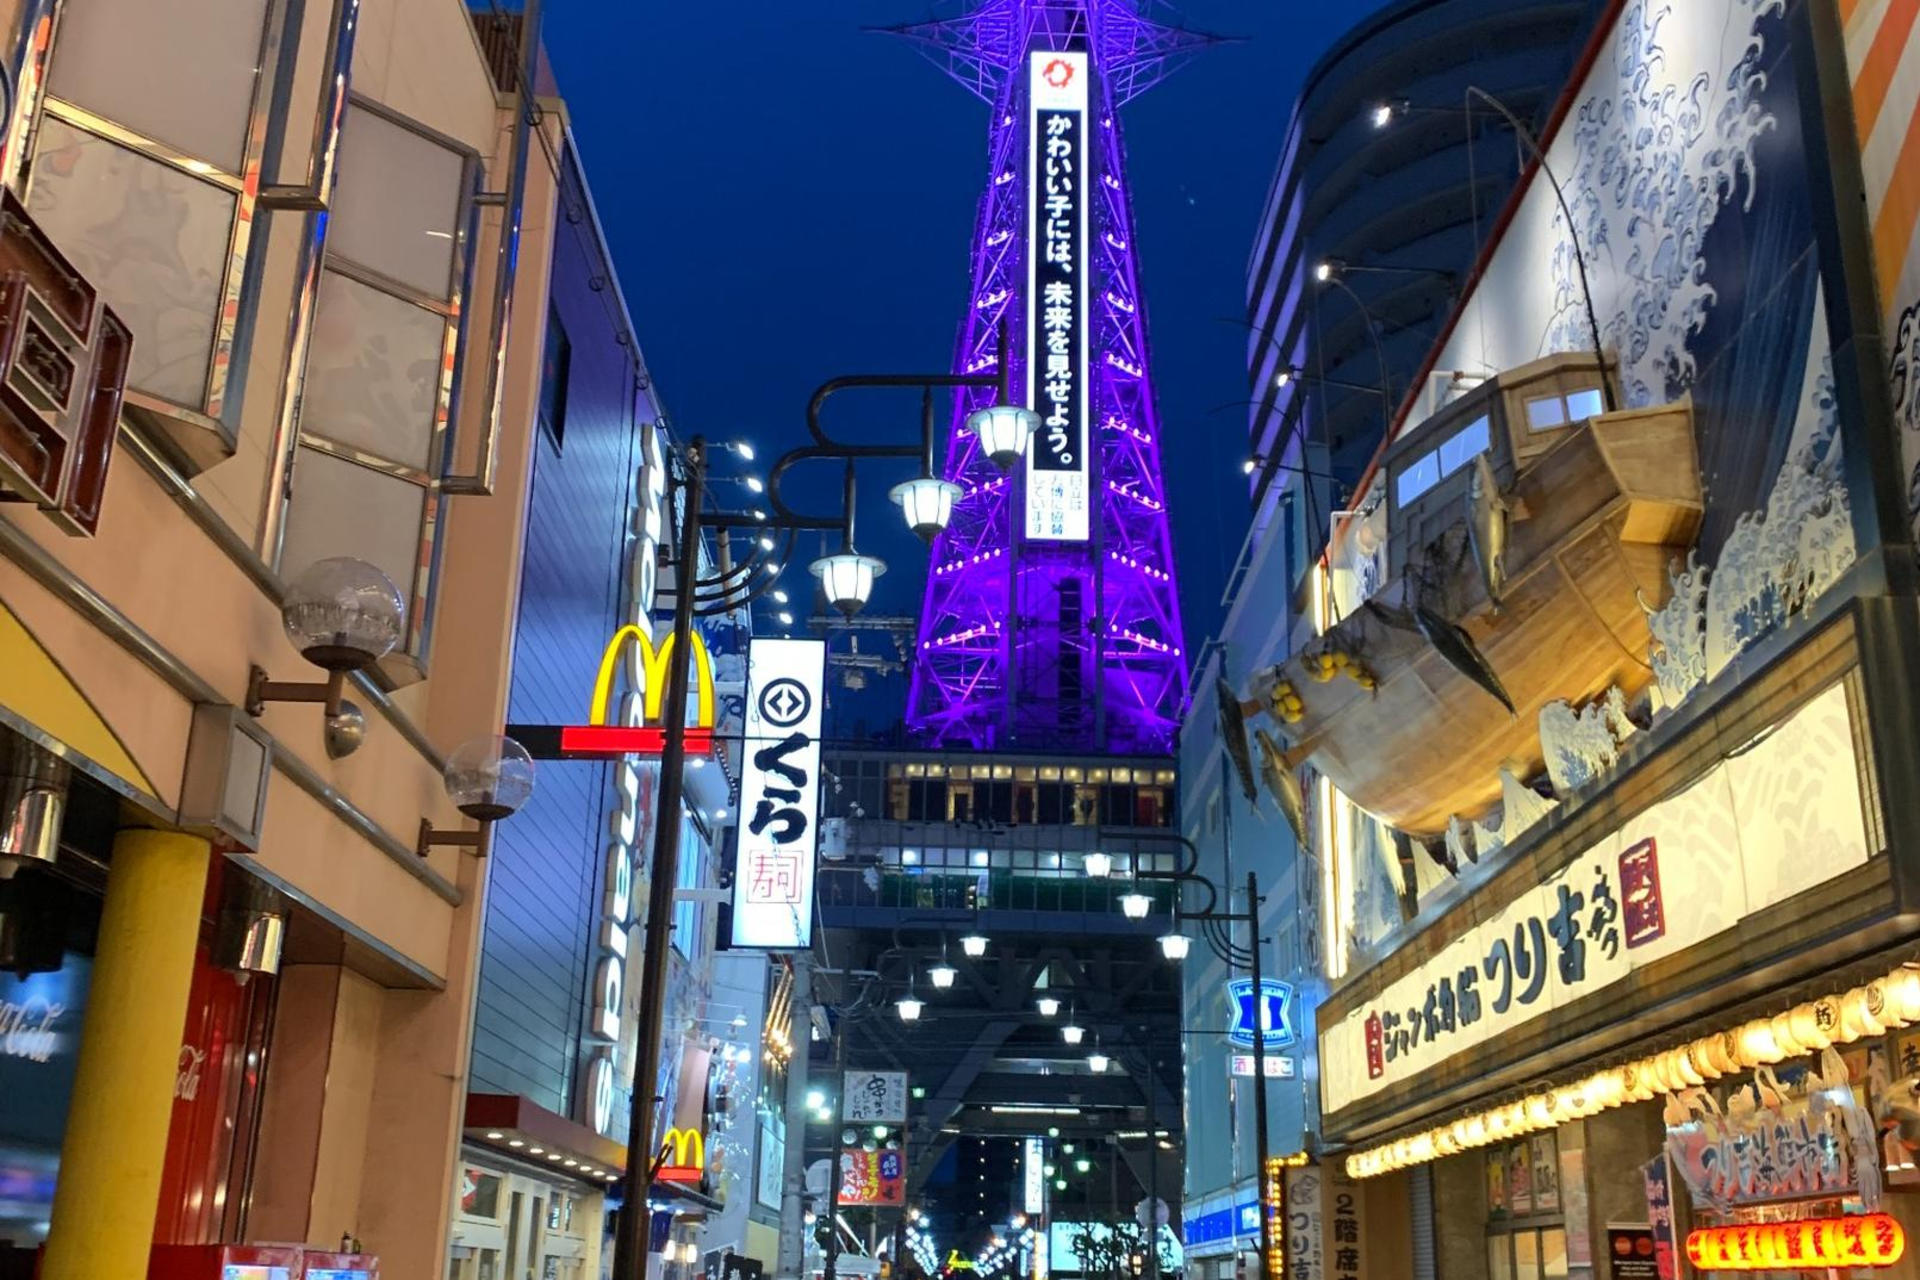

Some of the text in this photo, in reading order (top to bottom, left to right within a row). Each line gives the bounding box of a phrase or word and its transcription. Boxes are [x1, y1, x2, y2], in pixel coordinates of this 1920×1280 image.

[749, 732, 810, 845] くら
[753, 854, 798, 898] 寿司
[1483, 884, 1586, 1014] つり吉
[1333, 1193, 1360, 1280] 2階席
